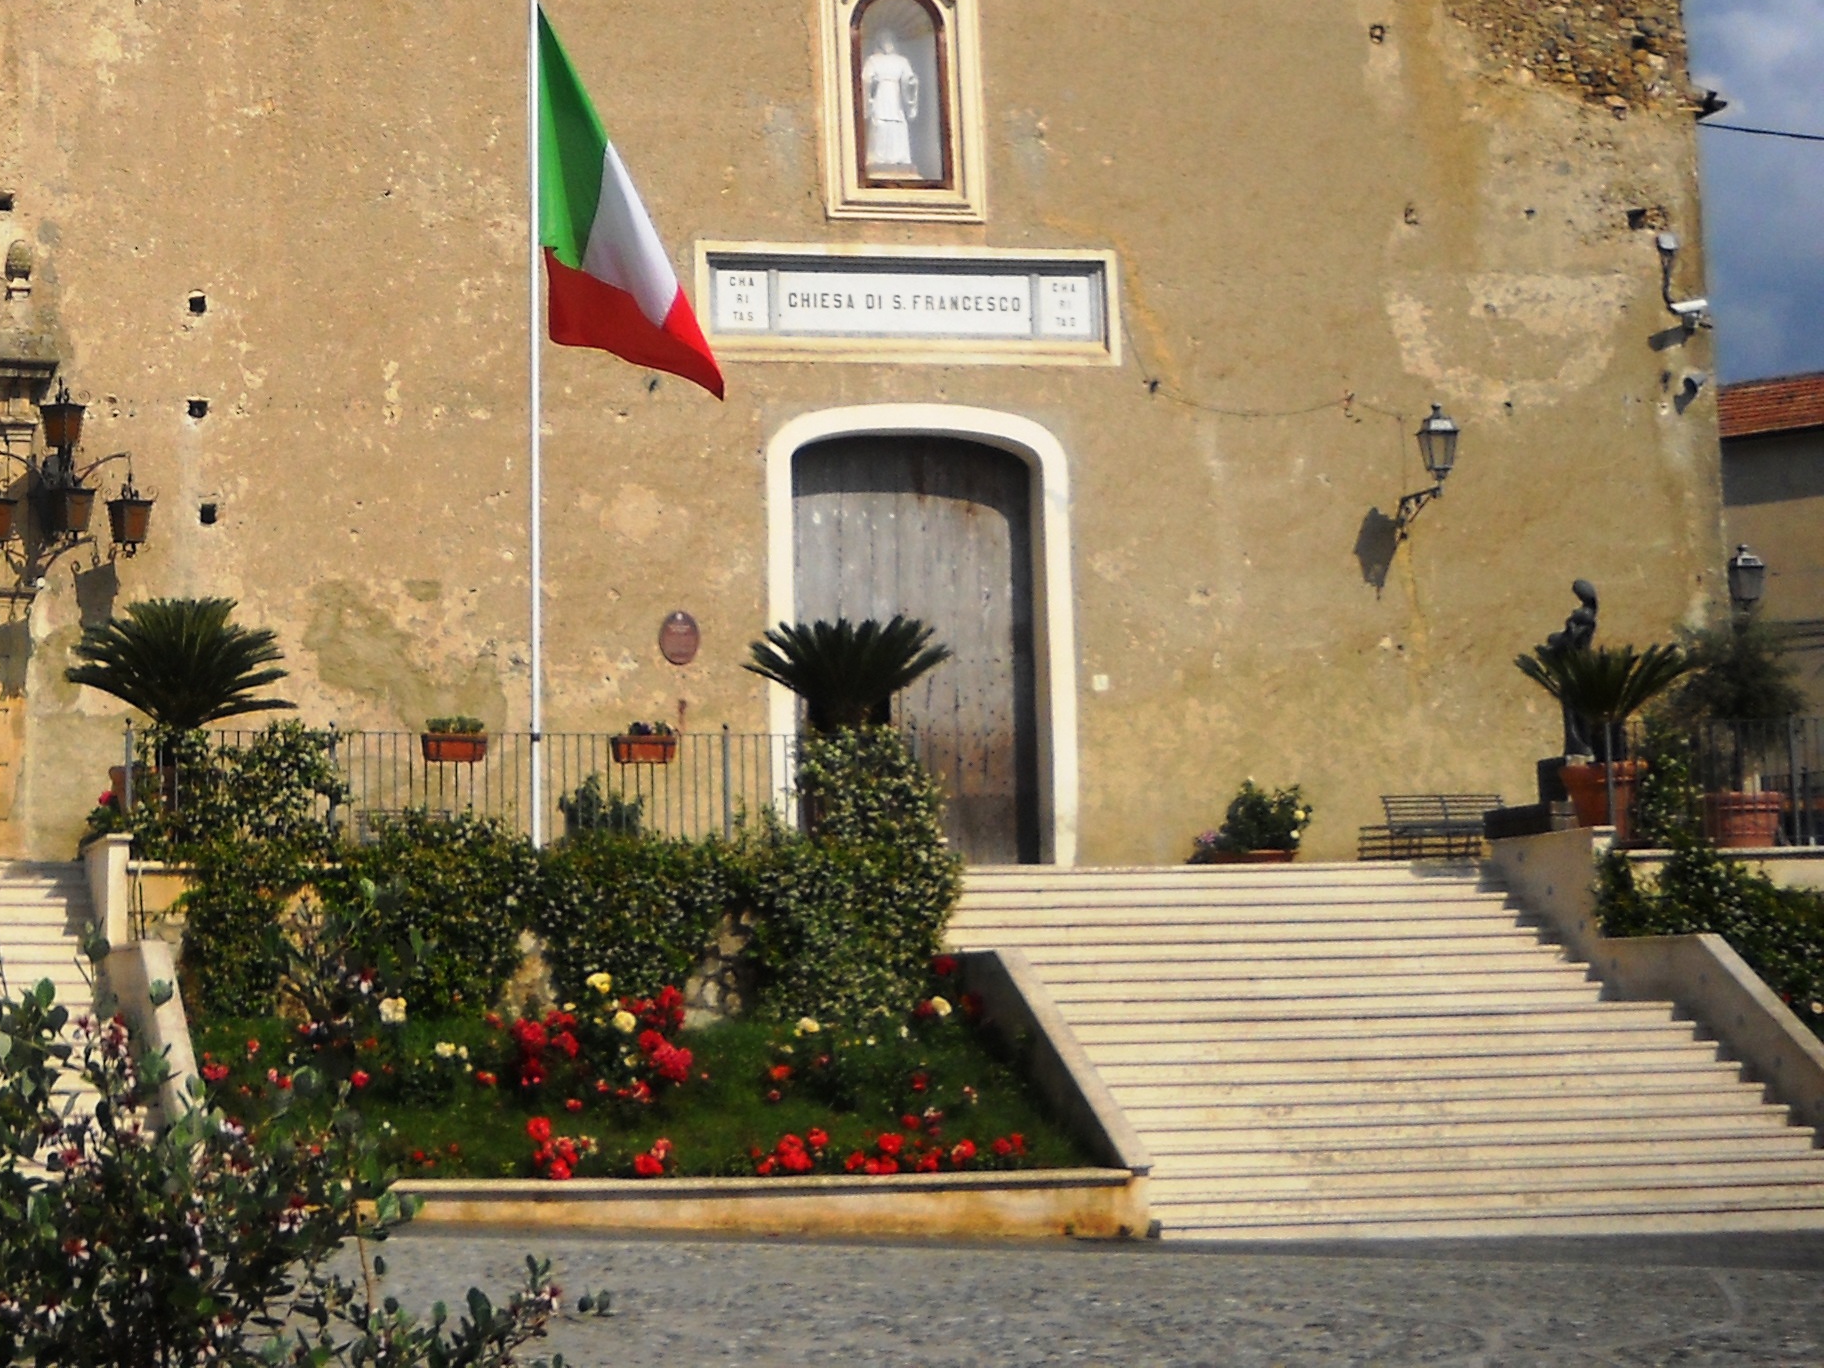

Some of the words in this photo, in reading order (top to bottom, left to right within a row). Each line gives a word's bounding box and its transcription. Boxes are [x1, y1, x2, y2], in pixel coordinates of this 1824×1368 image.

[729, 276, 754, 287] CHA
[737, 293, 749, 304] RI
[788, 292, 855, 309] CHIESA
[865, 293, 882, 309] DI
[892, 294, 907, 310] S.
[912, 295, 1021, 312] FRANCESCO
[733, 311, 754, 322] TAS
